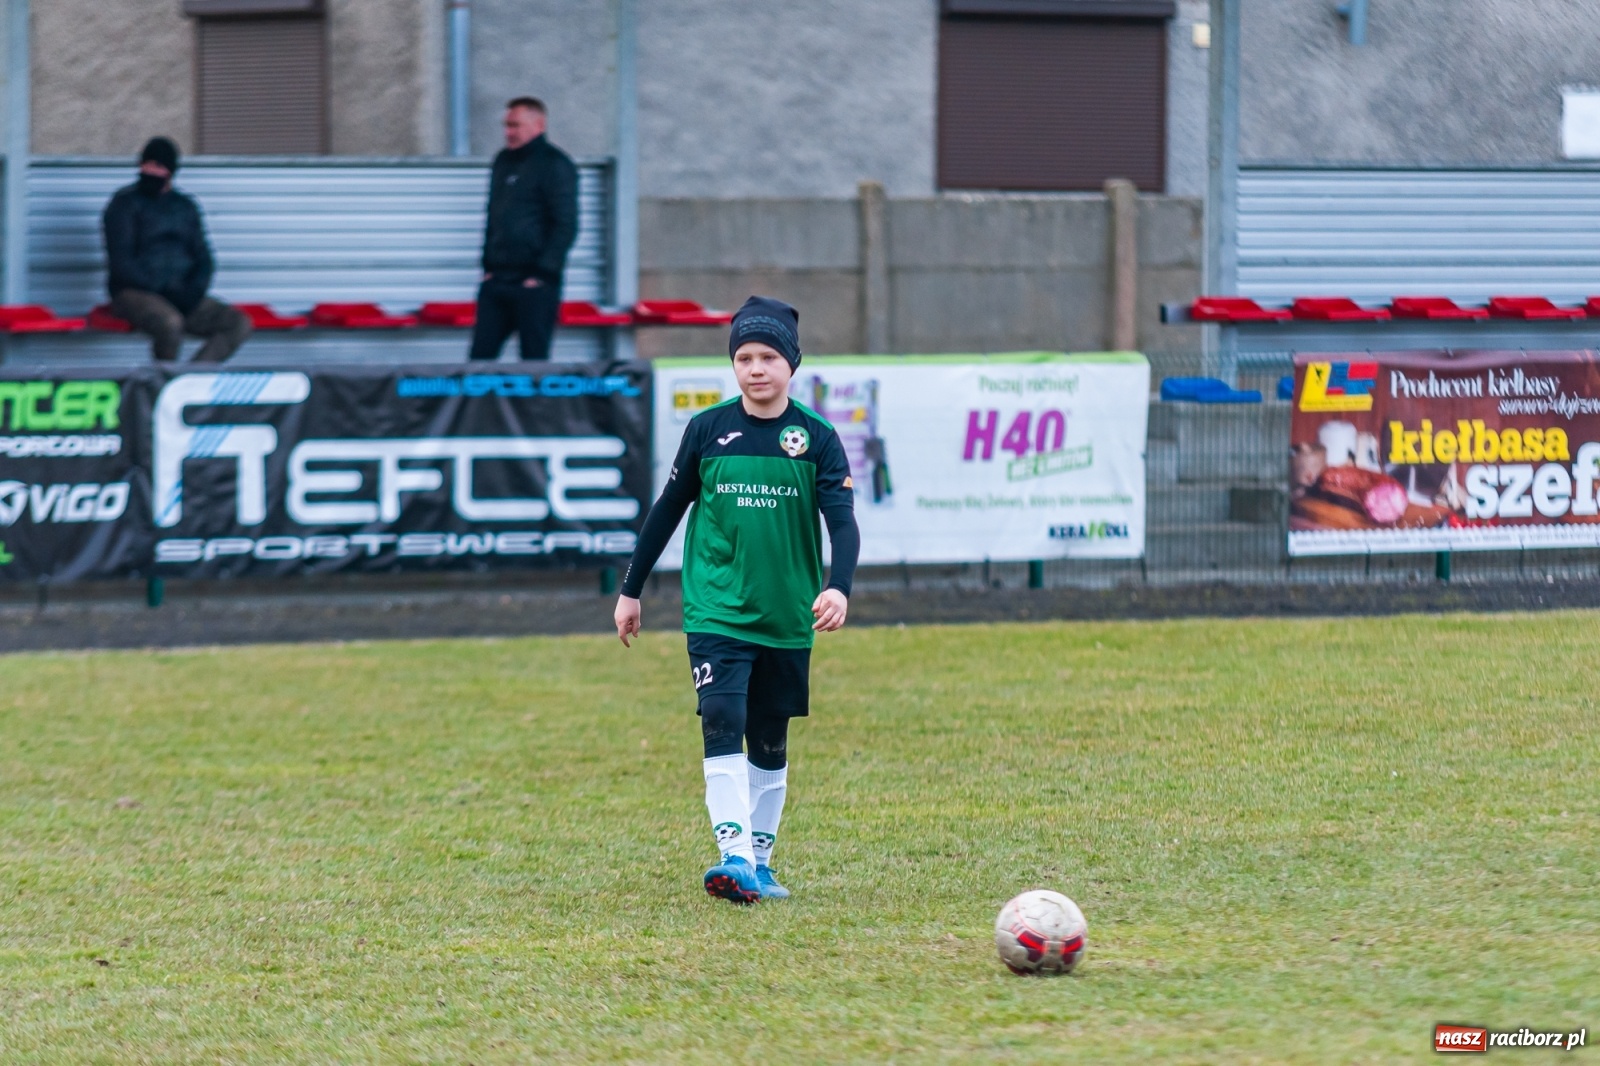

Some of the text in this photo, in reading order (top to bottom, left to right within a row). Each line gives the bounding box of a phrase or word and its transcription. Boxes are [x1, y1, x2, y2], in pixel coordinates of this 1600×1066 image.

[963, 409, 1065, 460] H40
[1389, 418, 1570, 464] kiełbasa
[716, 483, 799, 497] RESTAURACJA
[1464, 441, 1600, 520] szef
[736, 497, 777, 509] BRAVO
[693, 662, 713, 690] 22
